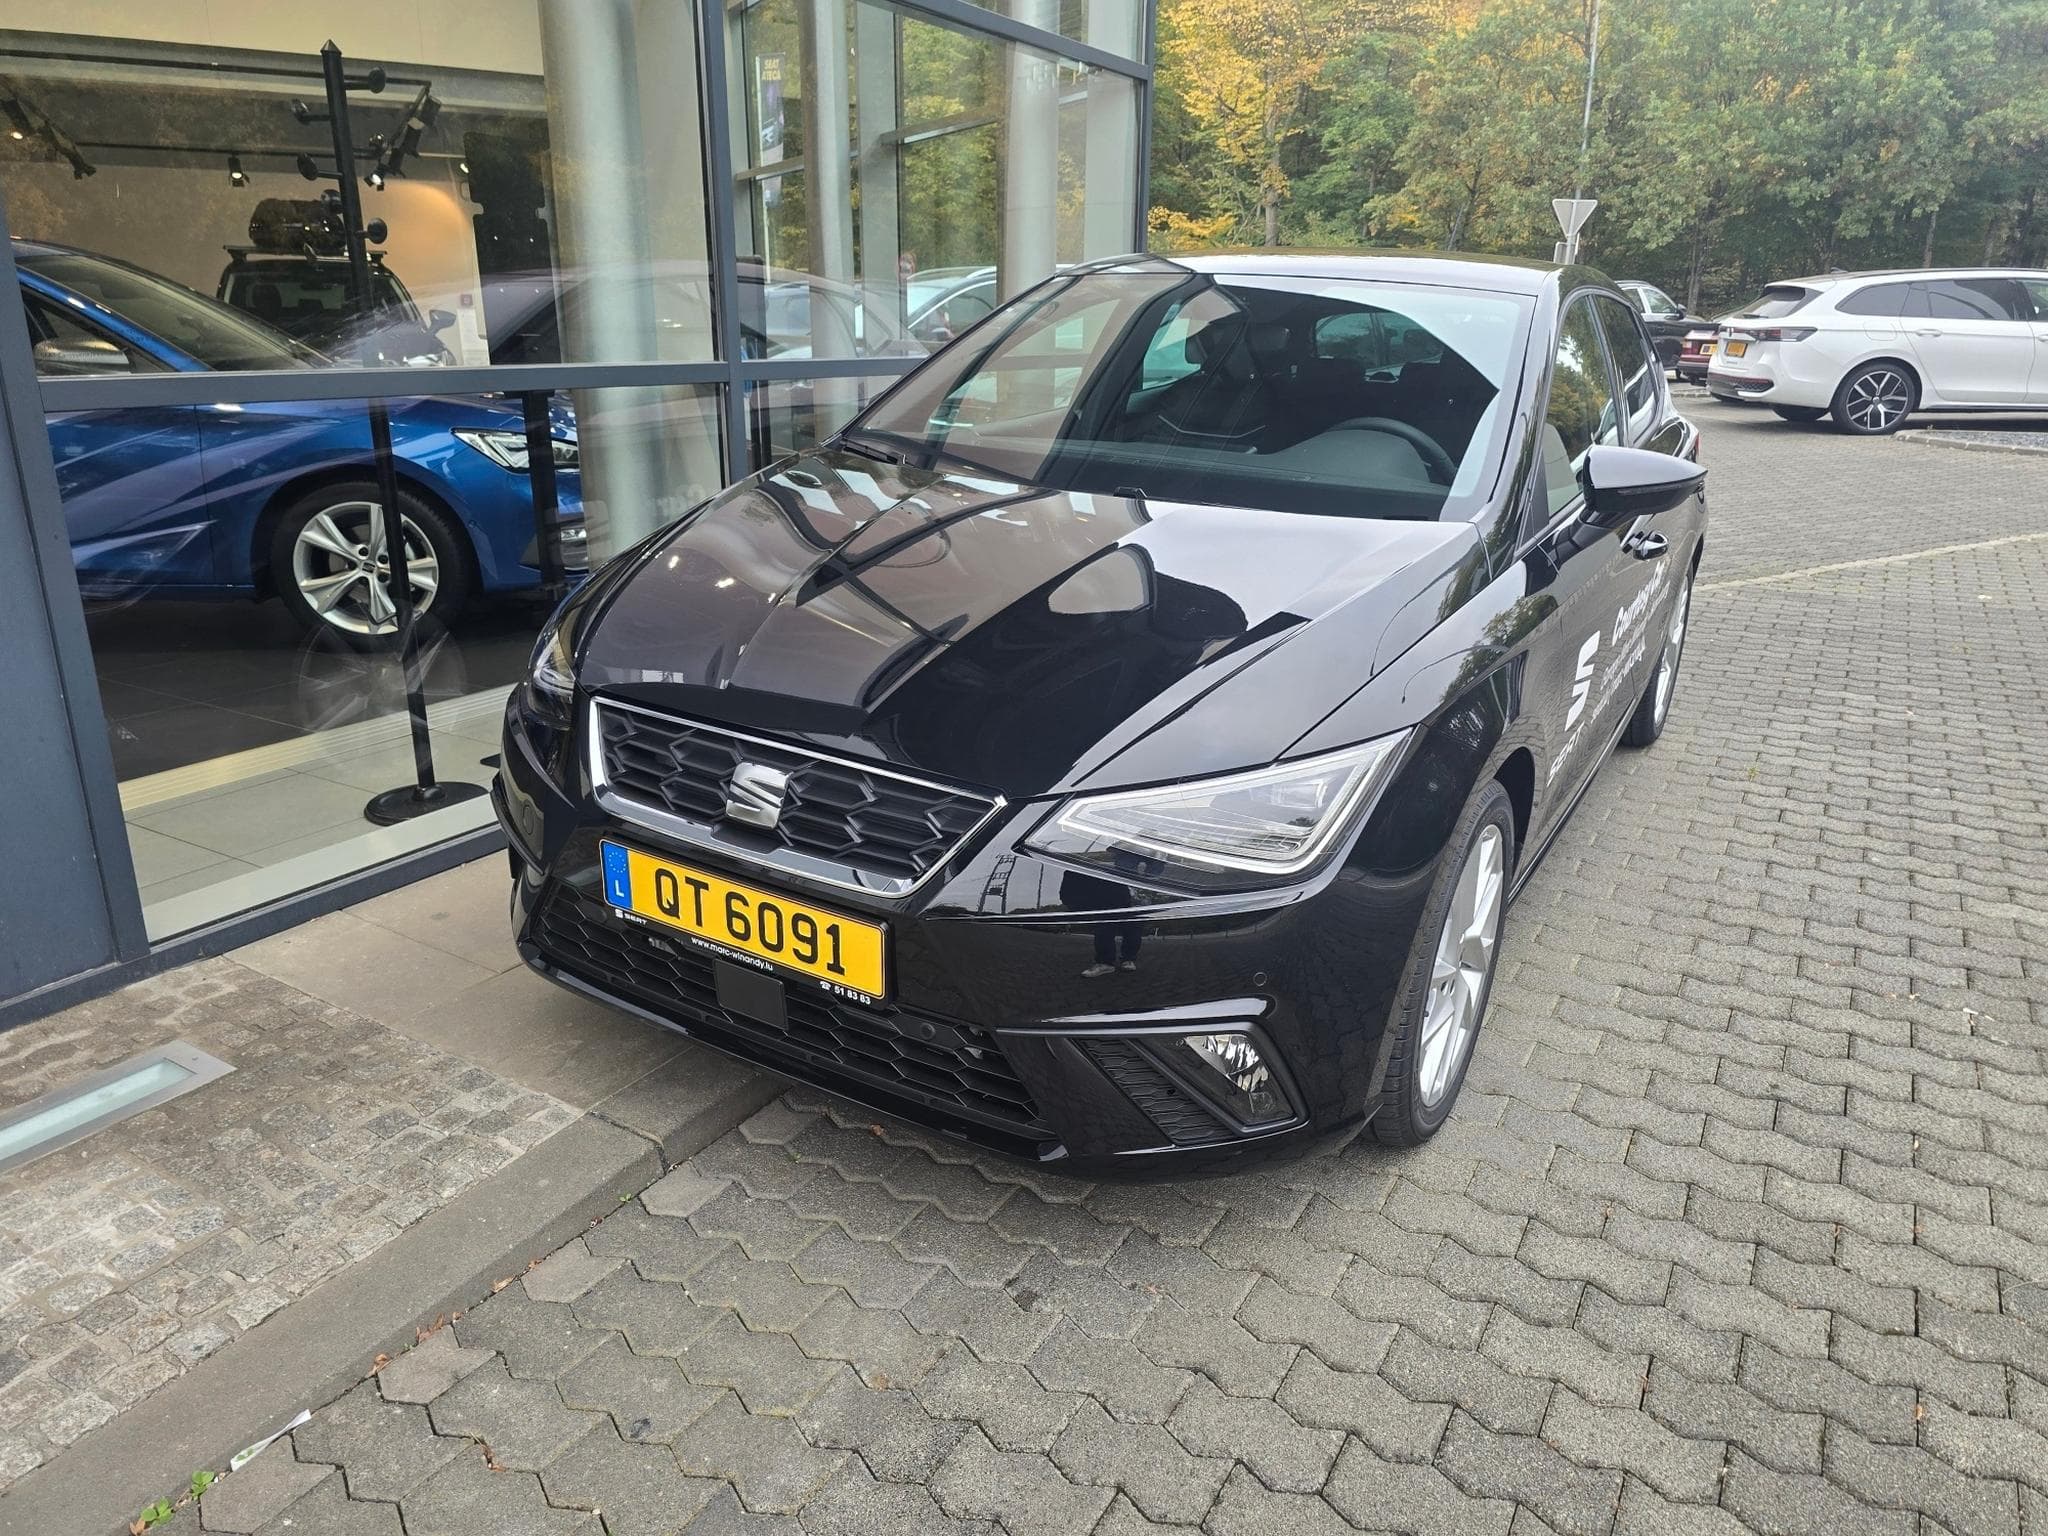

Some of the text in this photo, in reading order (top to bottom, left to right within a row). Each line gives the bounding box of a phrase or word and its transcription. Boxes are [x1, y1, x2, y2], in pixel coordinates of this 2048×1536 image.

[1546, 720, 1585, 788] SEAT
[615, 880, 625, 897] L
[624, 913, 648, 926] SEAT
[655, 868, 846, 975] QT 6091
[691, 936, 774, 971] www.marc-winandy.lu
[834, 985, 845, 996] 51
